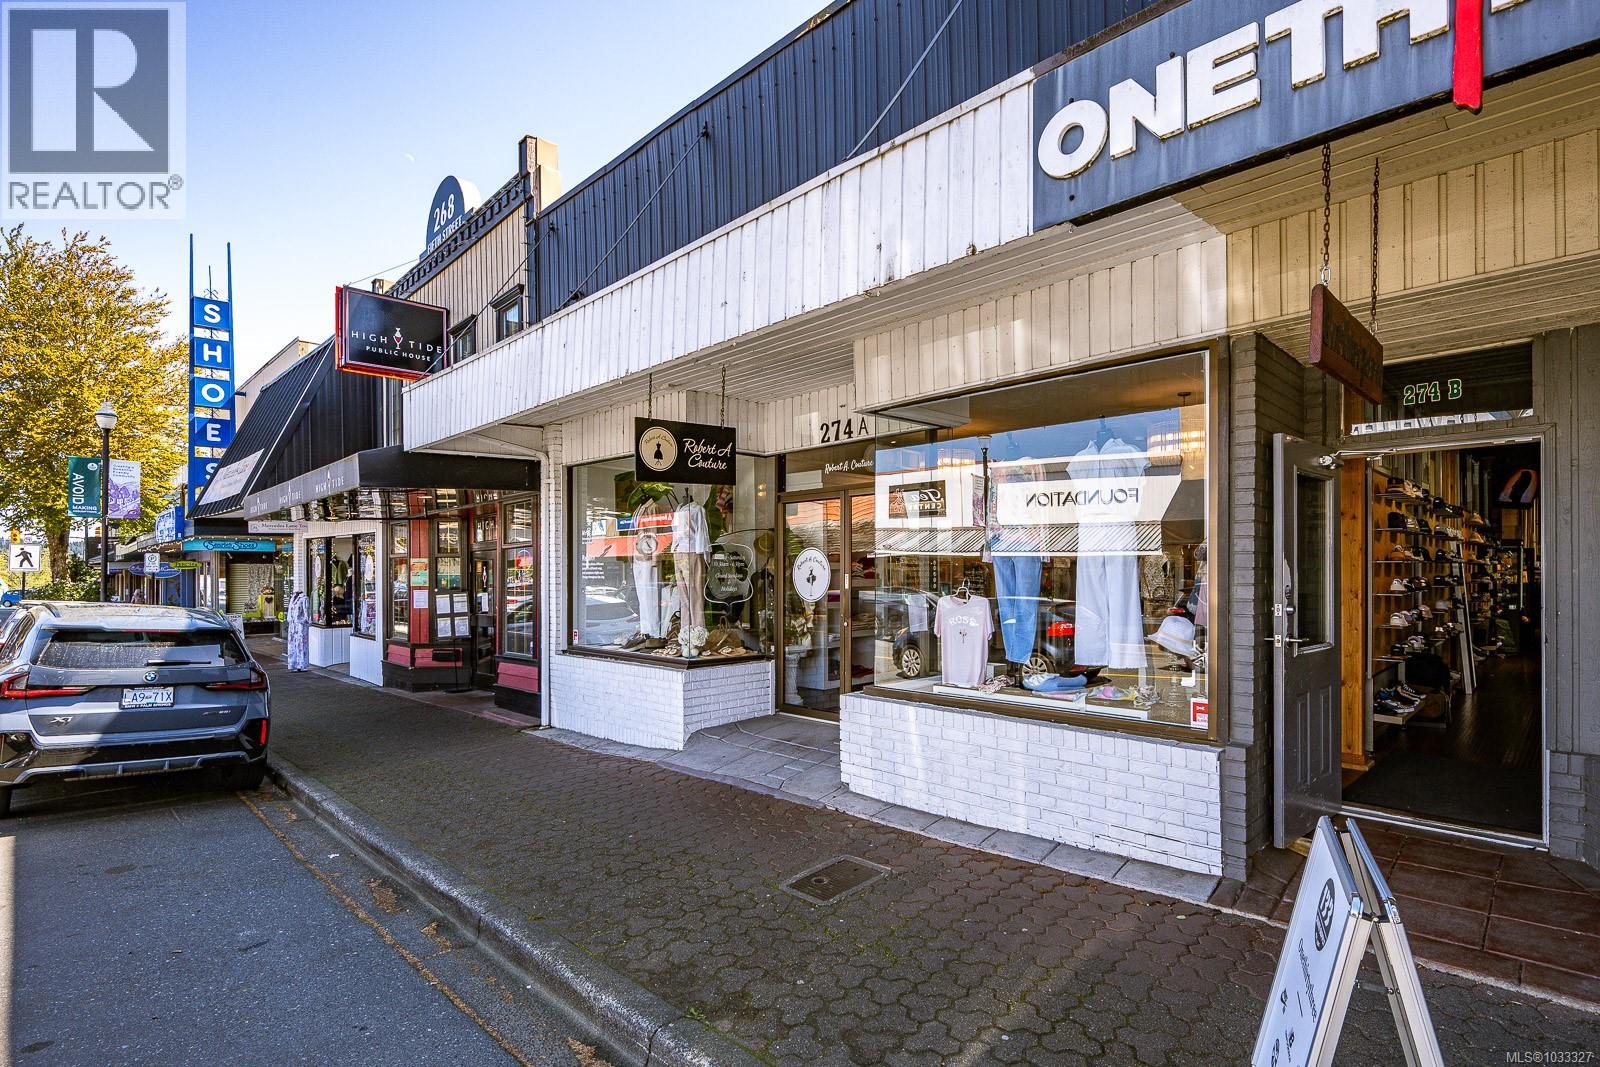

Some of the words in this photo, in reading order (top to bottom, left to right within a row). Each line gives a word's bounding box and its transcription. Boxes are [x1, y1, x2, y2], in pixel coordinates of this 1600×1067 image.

[433, 193, 455, 233] 268
[442, 214, 463, 240] STREET
[351, 330, 388, 344] HIGH
[408, 340, 442, 354] TIDE
[366, 345, 399, 356] PUBLIC
[402, 351, 431, 362] HOUSE
[1403, 381, 1440, 406] 274
[1448, 378, 1462, 400] B
[820, 418, 854, 443] 274
[858, 416, 869, 435] A
[682, 438, 717, 455] Robert
[717, 441, 733, 457] A
[687, 453, 728, 470] Couture
[825, 462, 843, 474] Robert
[851, 459, 874, 470] Couture
[72, 473, 84, 505] AVOID
